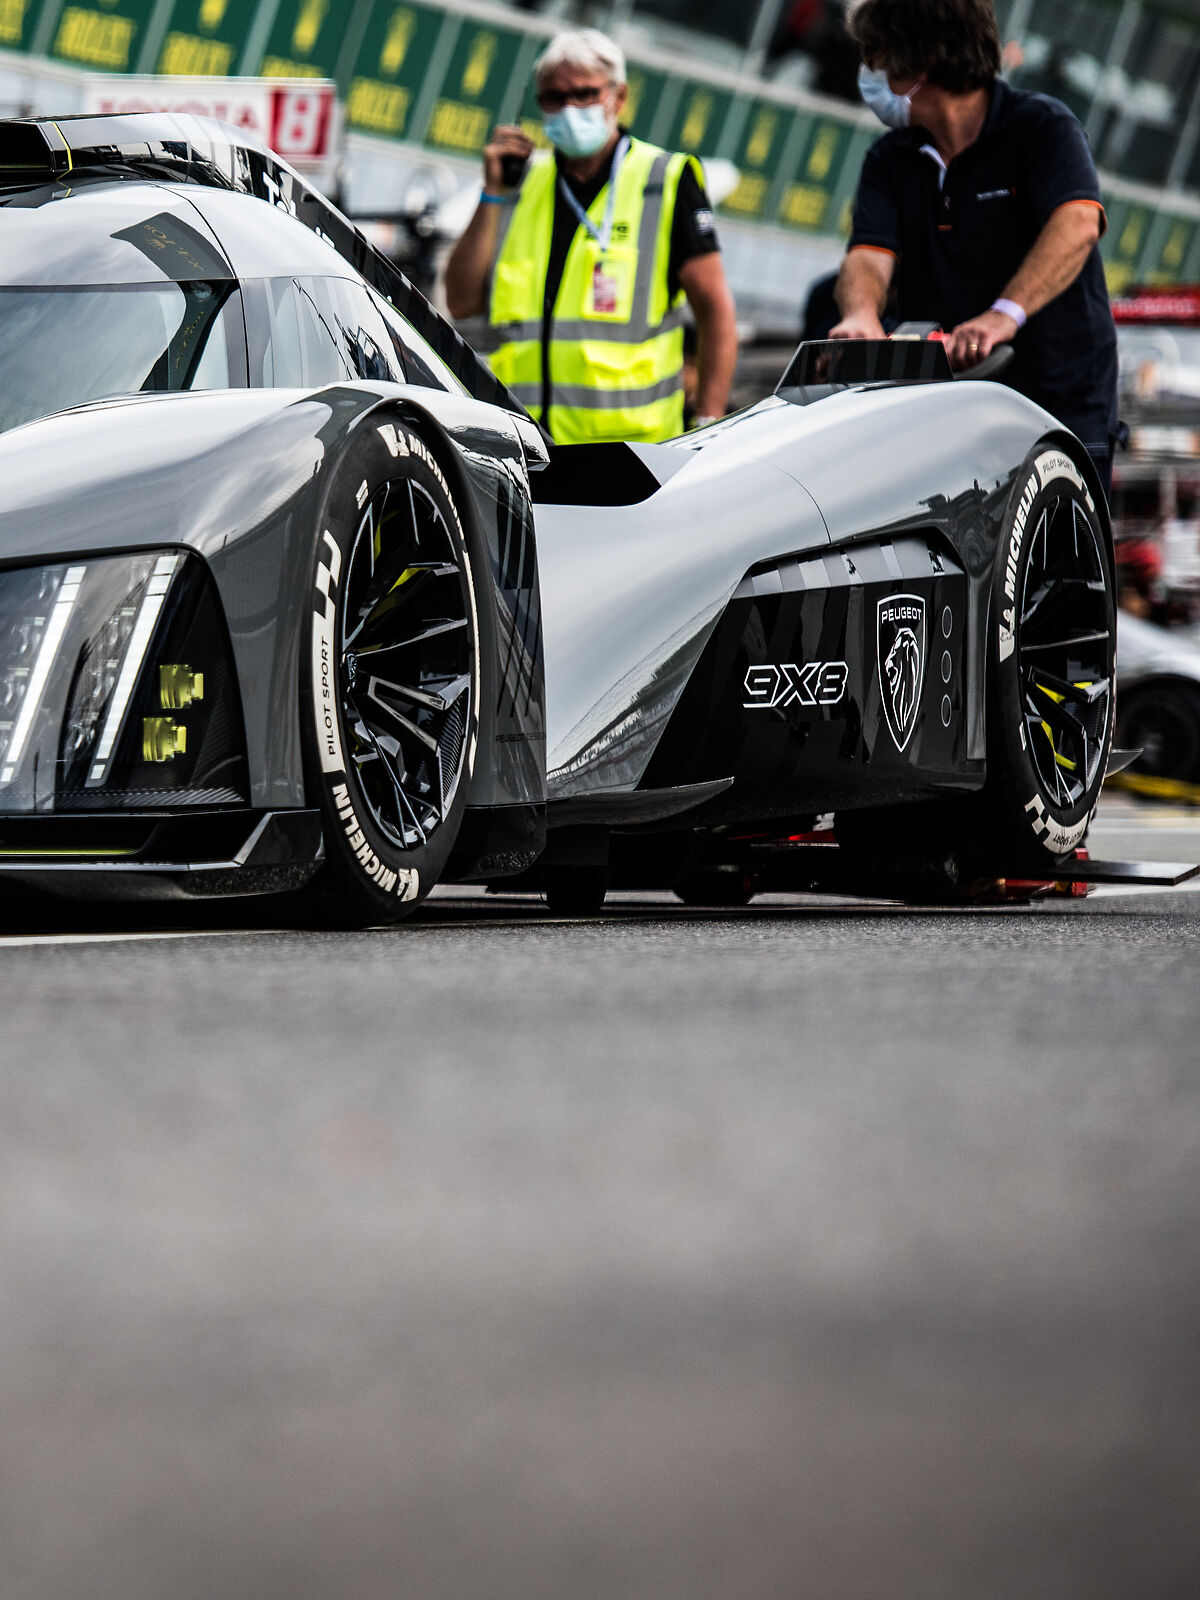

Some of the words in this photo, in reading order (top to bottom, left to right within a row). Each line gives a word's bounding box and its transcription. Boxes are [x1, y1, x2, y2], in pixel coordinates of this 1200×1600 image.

[279, 92, 321, 153] 8
[409, 433, 465, 541] MICHELIN
[1005, 473, 1039, 601] MICHELIN
[881, 606, 922, 624] PEUGEOT
[321, 635, 330, 699] SPORT
[743, 661, 849, 708] 9X8
[325, 704, 336, 756] PILOT
[332, 783, 397, 892] MICHELIN
